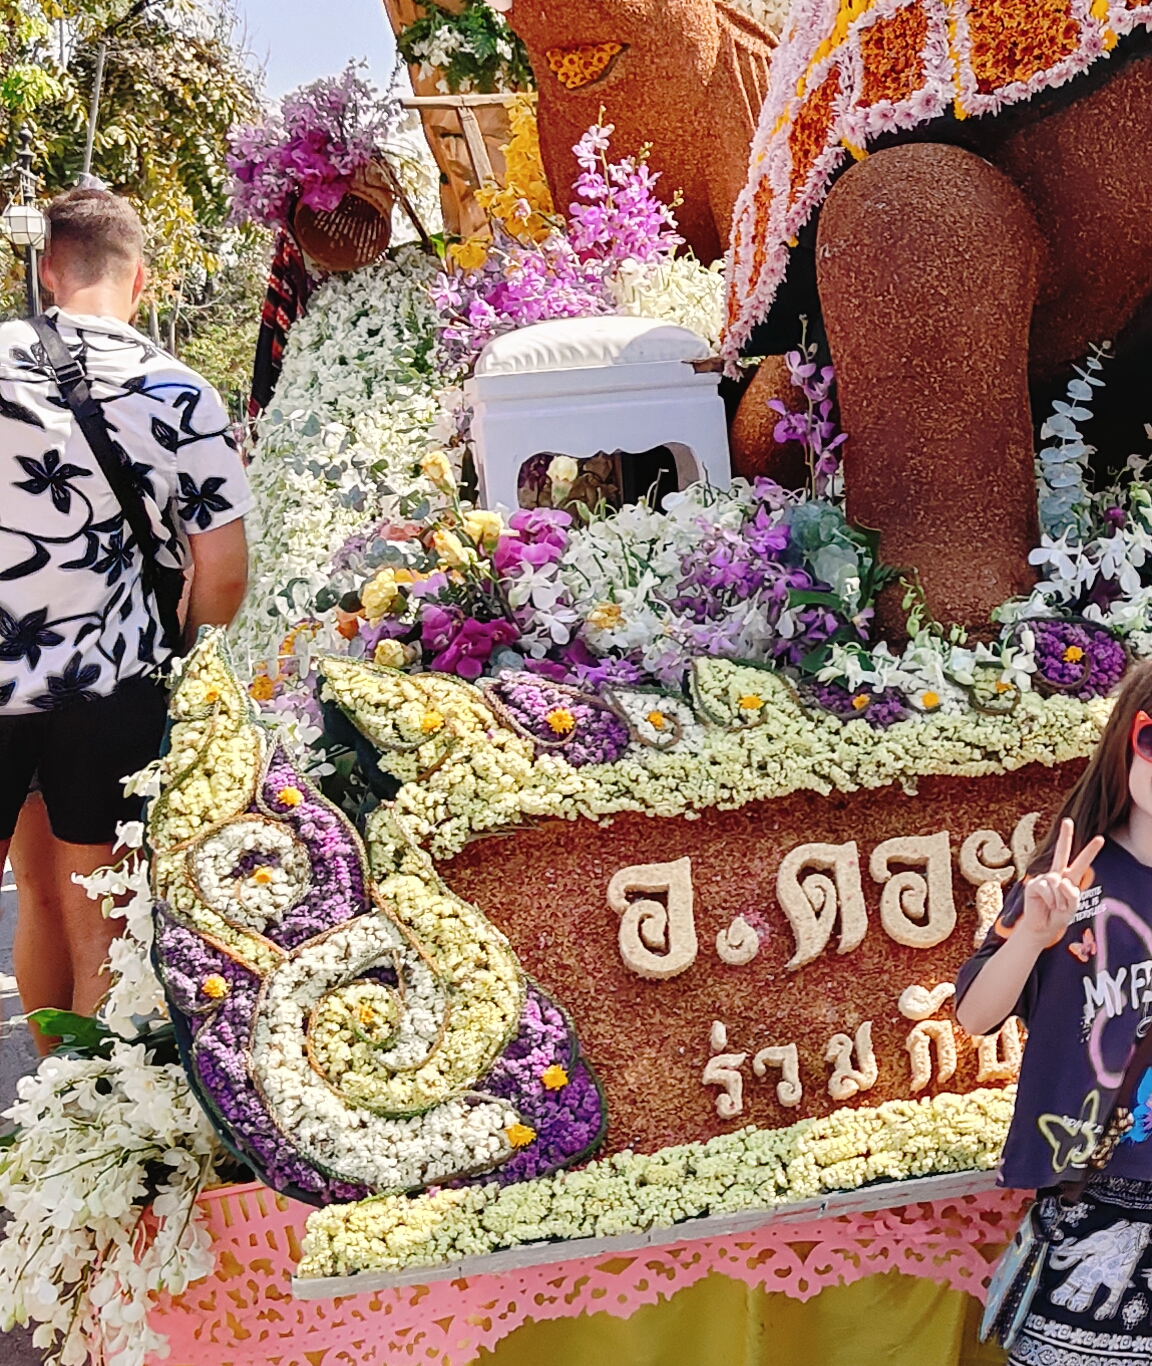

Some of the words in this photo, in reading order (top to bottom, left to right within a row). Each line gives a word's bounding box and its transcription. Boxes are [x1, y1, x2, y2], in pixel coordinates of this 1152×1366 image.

[607, 811, 1043, 981] อ.ดอย
[702, 981, 1028, 1121] ร่วมกับ
